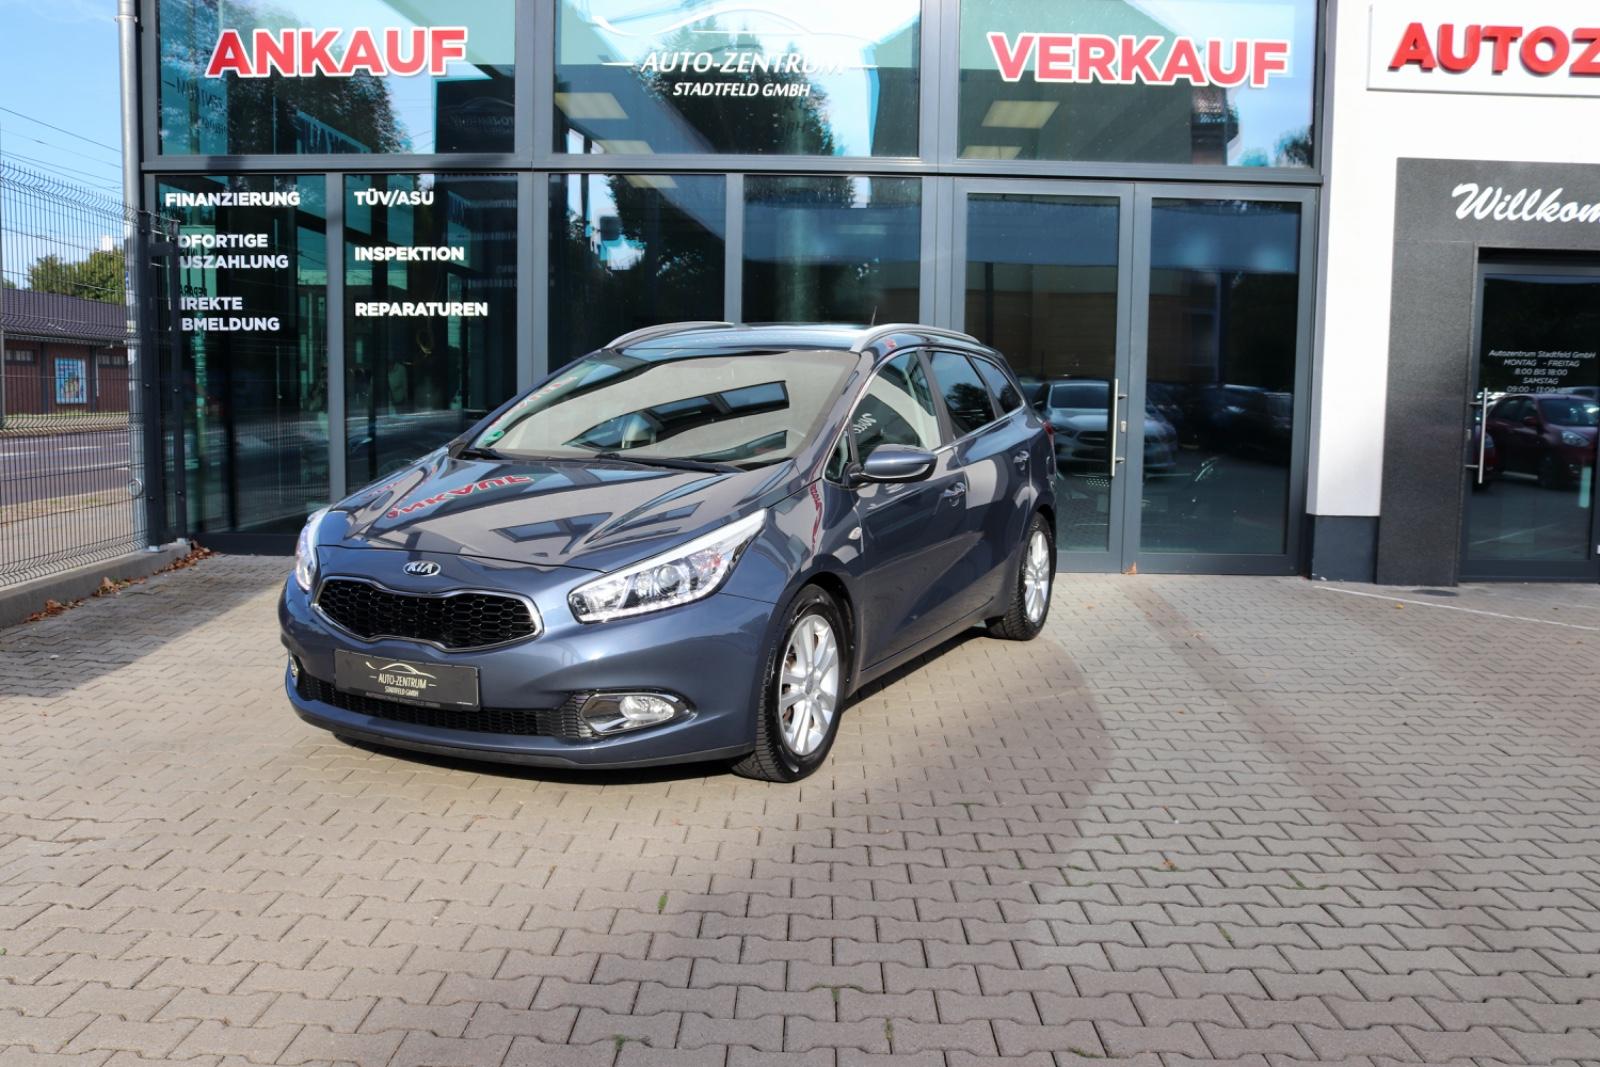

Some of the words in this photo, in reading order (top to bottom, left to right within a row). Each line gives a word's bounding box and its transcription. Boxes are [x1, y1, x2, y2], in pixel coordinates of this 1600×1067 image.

[205, 27, 468, 78] ANKAUF
[1387, 22, 1600, 77] AUTOZ
[986, 31, 1291, 88] VERKAUF
[672, 81, 760, 97] STADTFELD
[762, 83, 811, 97] GMBH
[165, 191, 301, 207] FINANZIERUNG
[354, 188, 435, 207] TÜV/ASU
[166, 233, 269, 248] OFORTIGE
[354, 246, 465, 261] INSPEKTION
[167, 254, 289, 269] USZAHLUNG
[168, 296, 243, 311] IREKTE
[354, 302, 489, 317] REPARATUREN
[168, 317, 281, 332] BMELDUNG
[1537, 350, 1571, 358] Stadtfeld
[407, 561, 433, 574] KIA
[378, 673, 427, 689] AUTO-ZENTRUM
